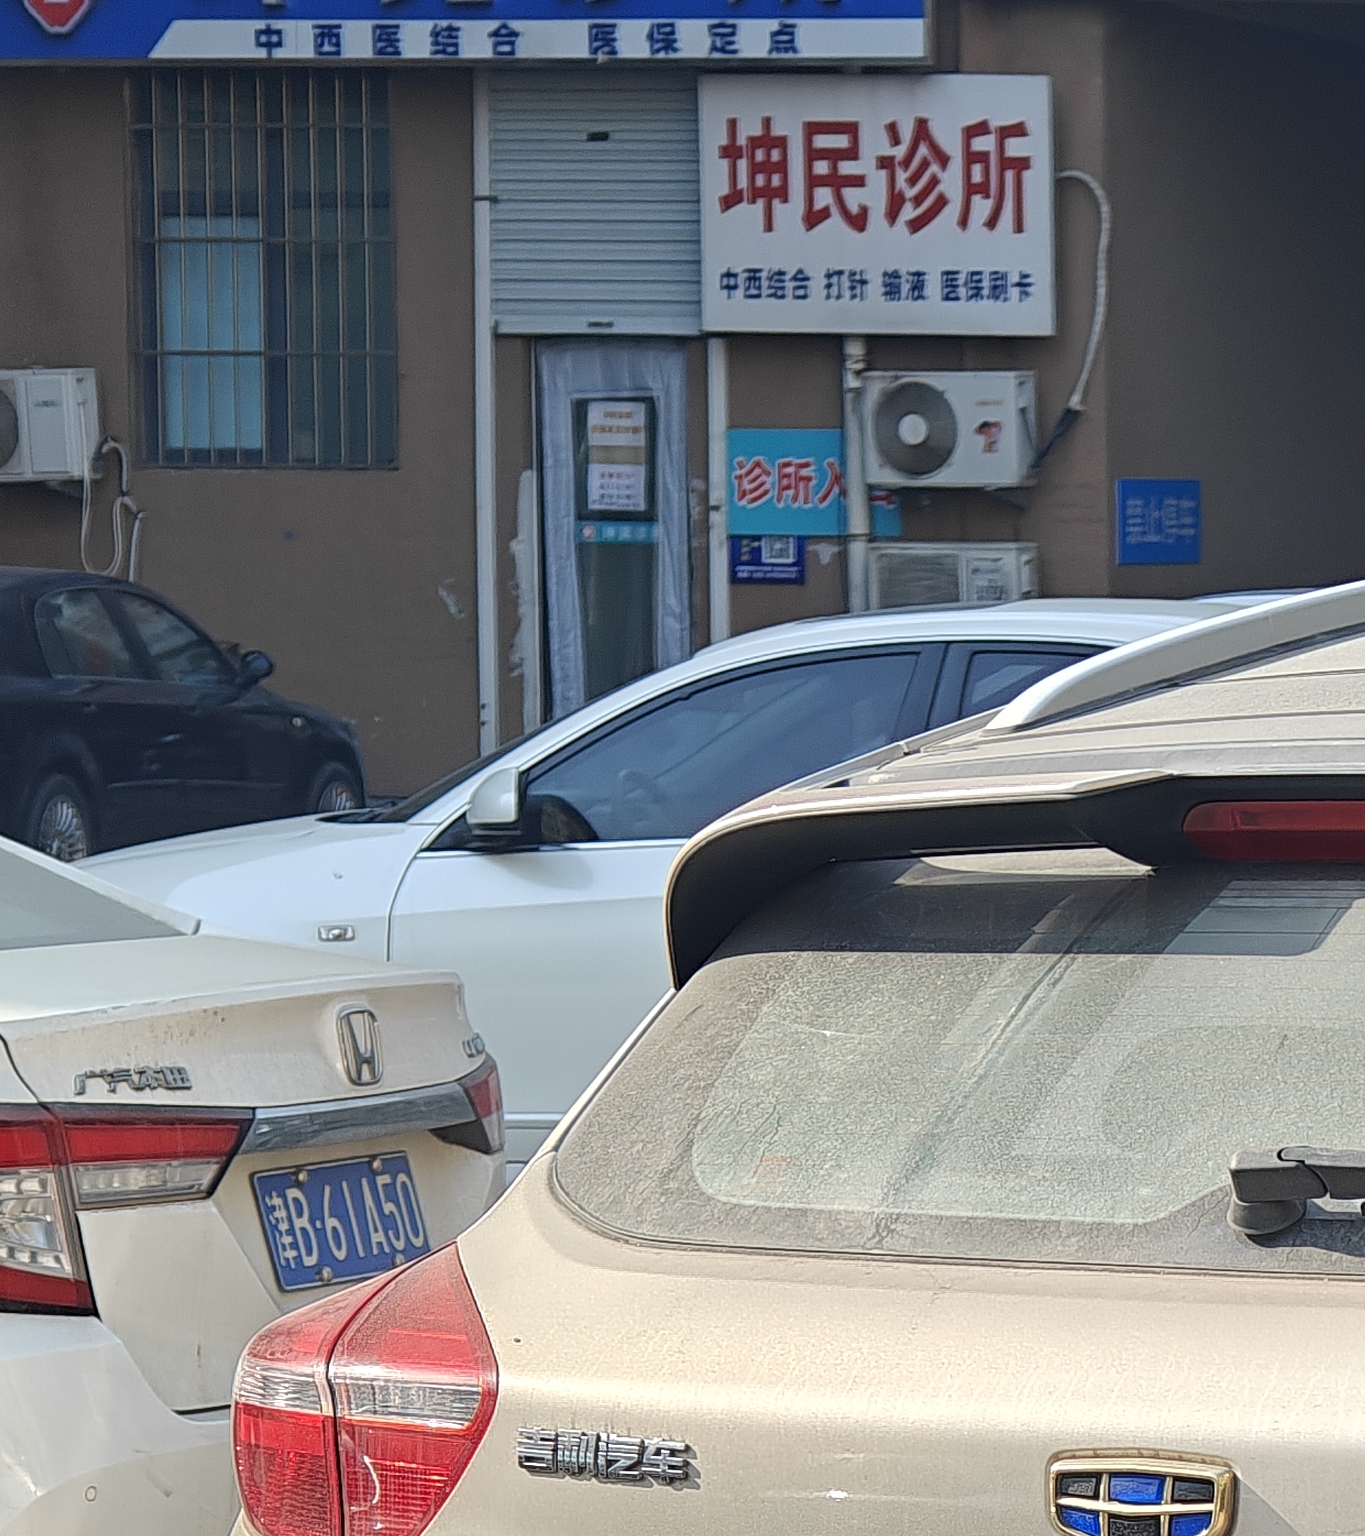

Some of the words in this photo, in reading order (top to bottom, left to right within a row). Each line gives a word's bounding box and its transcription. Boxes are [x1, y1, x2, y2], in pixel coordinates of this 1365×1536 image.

[254, 23, 522, 58] 中西医结合
[588, 22, 800, 57] 医保定点
[717, 115, 1032, 236] 坤民诊所
[719, 268, 812, 302] 中西结合
[823, 269, 870, 302] 打针
[881, 269, 930, 302] 输液
[940, 270, 1036, 304] 医保刷卡
[733, 456, 896, 508] 诊所入
[73, 1065, 192, 1096] 广汽本田
[516, 1426, 690, 1484] 吉利汽车
